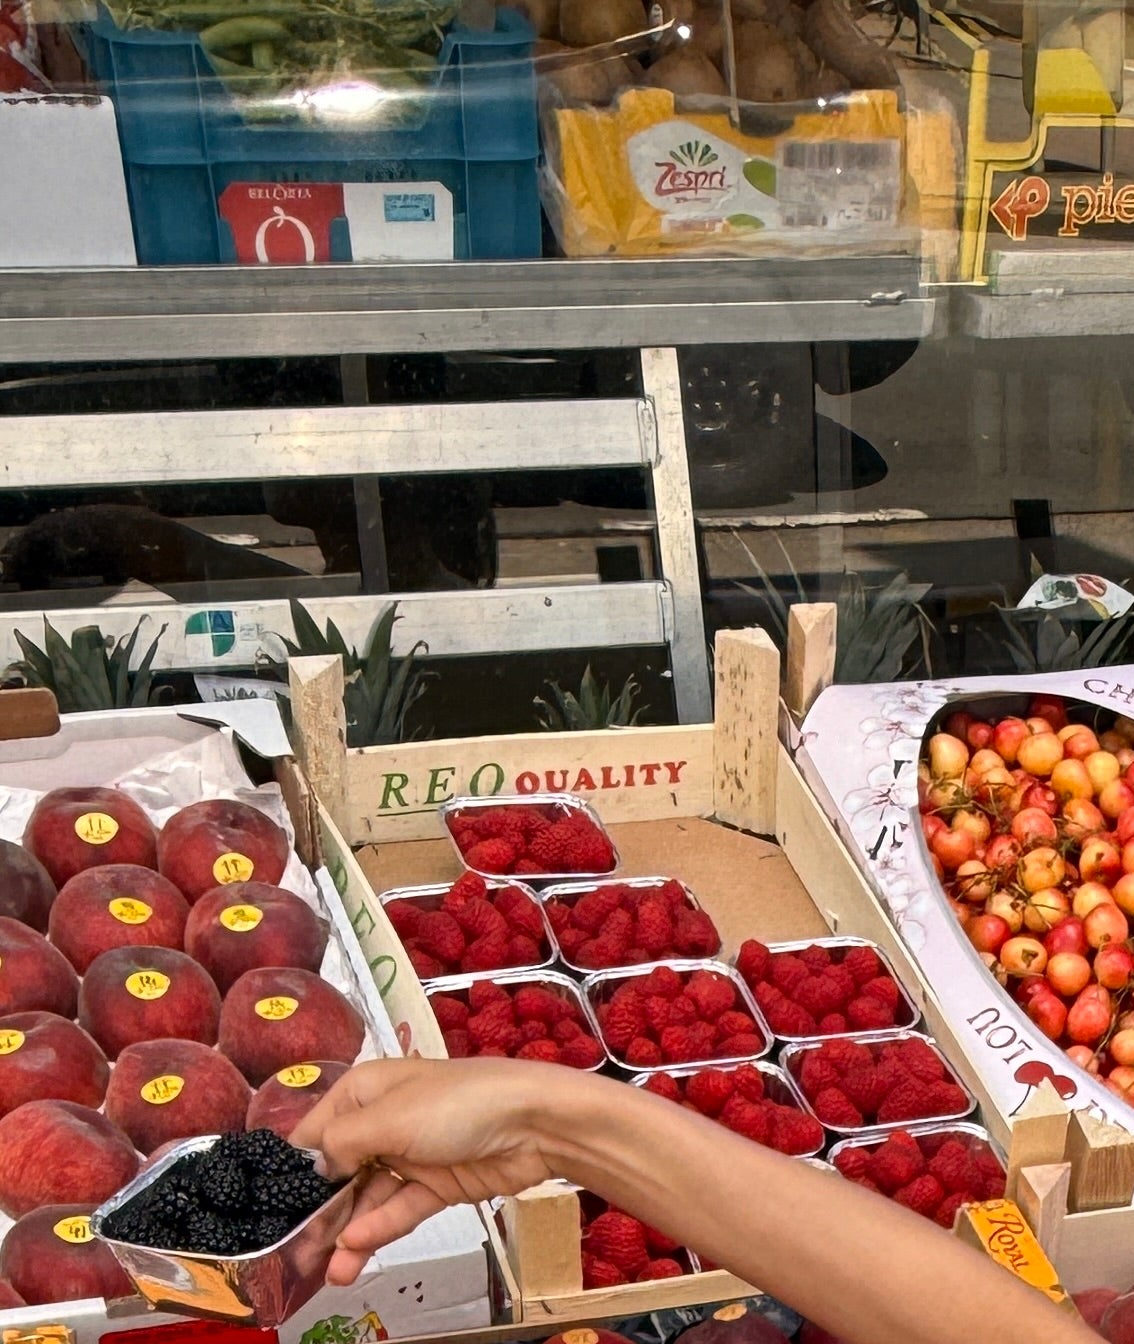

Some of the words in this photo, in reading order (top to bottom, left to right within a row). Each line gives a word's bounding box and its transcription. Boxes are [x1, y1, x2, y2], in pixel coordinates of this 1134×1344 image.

[654, 161, 729, 196] Zespri
[377, 762, 505, 809] REO
[515, 760, 687, 795] QUALITY
[966, 1007, 1034, 1065] LOU
